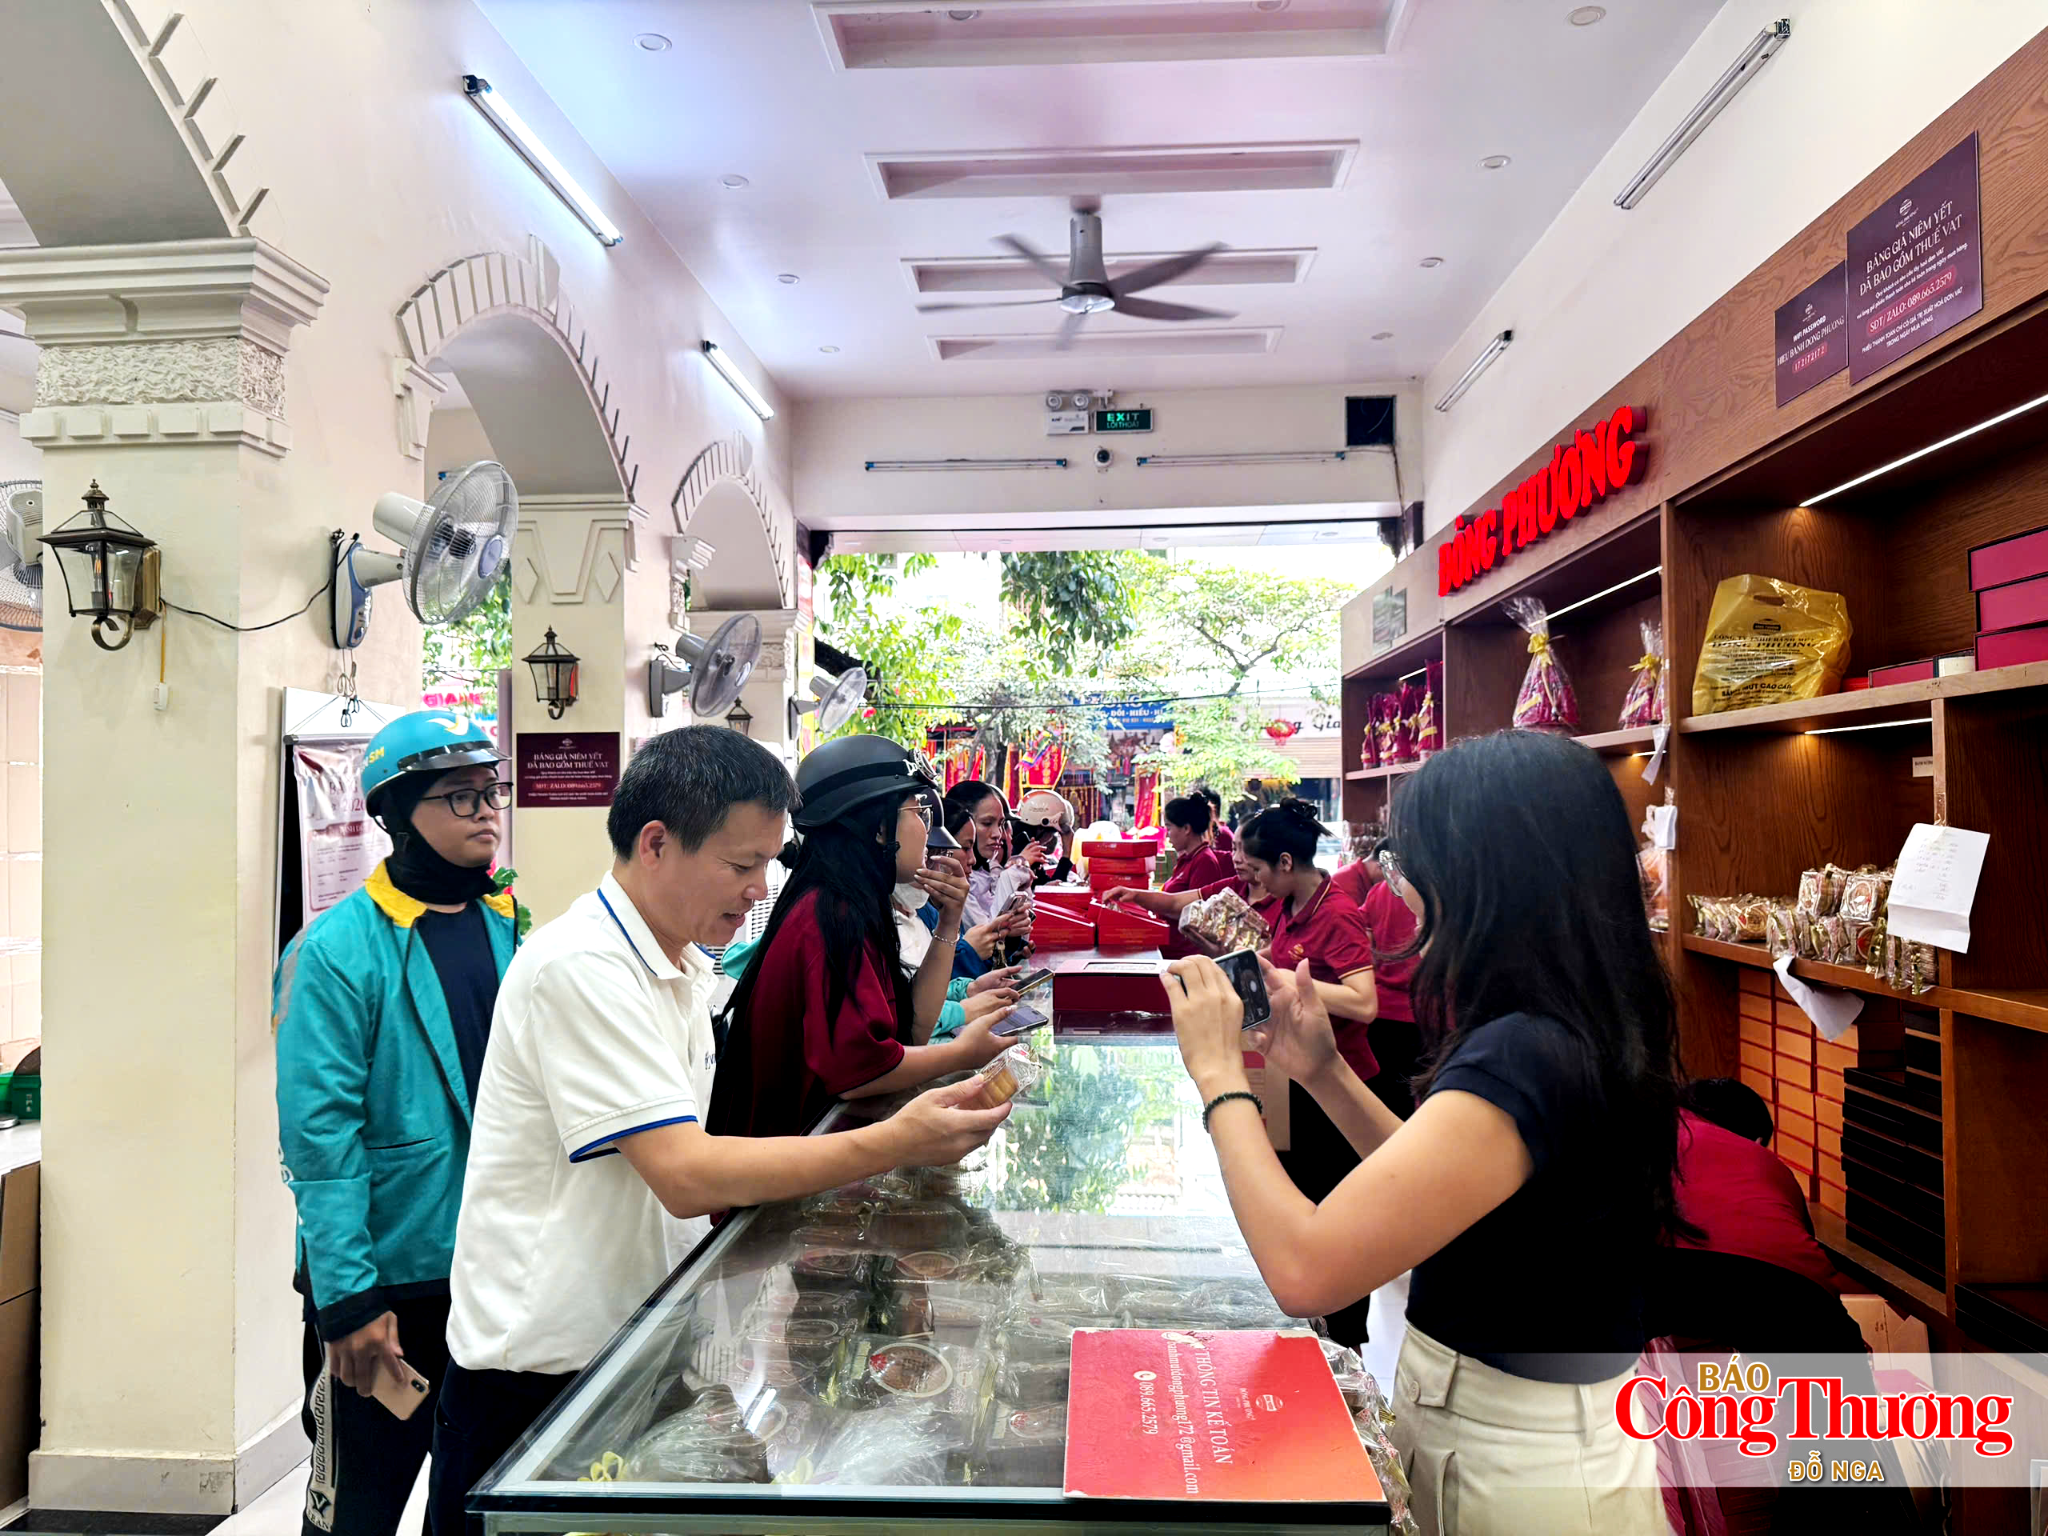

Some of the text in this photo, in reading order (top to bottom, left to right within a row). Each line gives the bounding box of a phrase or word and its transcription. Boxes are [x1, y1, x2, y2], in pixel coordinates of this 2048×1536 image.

[1859, 275, 1871, 295] ĐÃ
[1873, 265, 1891, 286] BAO
[1892, 248, 1913, 272] GỒM
[1914, 224, 1940, 256] THUẾ
[1942, 213, 1961, 235] VAT
[1866, 247, 1890, 273] BẢNG
[1891, 231, 1906, 254] GIÁ
[1908, 216, 1931, 242] NIÊM
[1933, 200, 1952, 223] YẾT
[1802, 315, 1826, 335] PASSWORD
[1886, 302, 1906, 321] ZALO:
[1907, 271, 1951, 307] 089.665.2579
[1106, 413, 1140, 422] EXIT
[1502, 405, 1635, 556] PHƯƠNG
[1139, 1381, 1158, 1434] 089.665.2579
[1194, 1350, 1235, 1464] THÔNG TIN KẾ TOÁN
